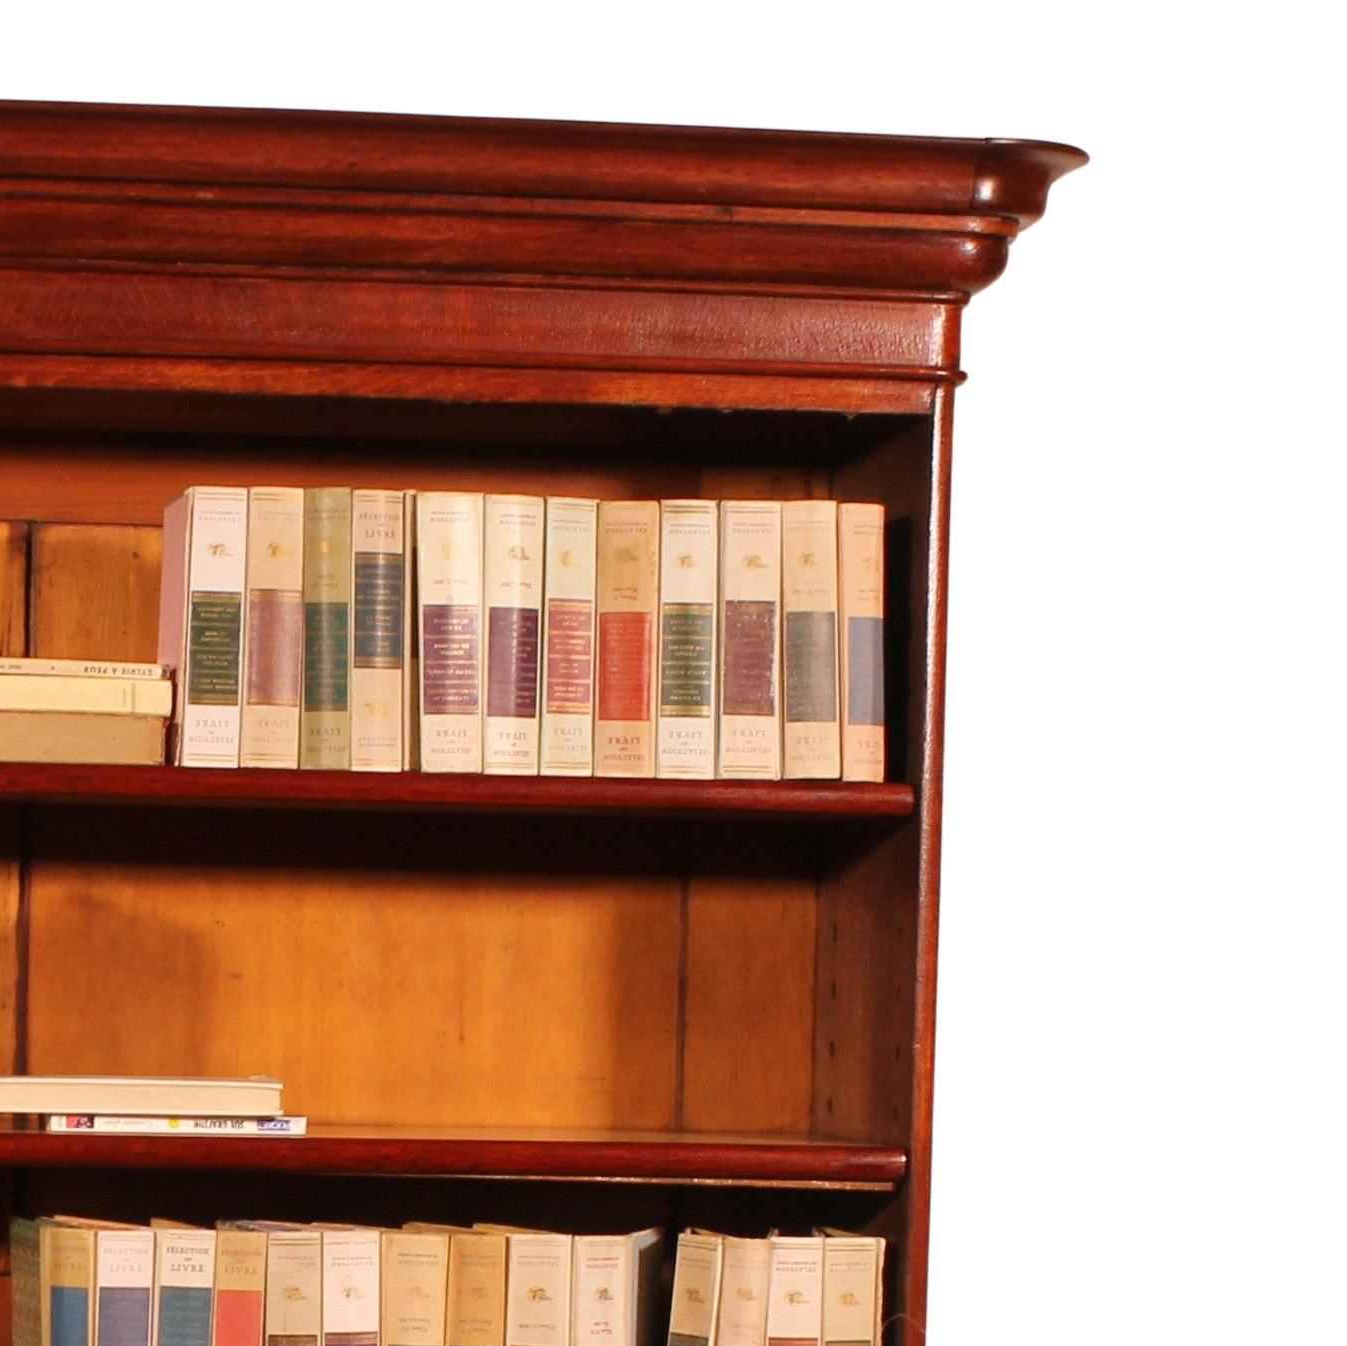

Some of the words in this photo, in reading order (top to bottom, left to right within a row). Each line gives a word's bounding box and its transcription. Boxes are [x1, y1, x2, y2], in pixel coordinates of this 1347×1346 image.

[83, 666, 107, 675] PEUR
[121, 667, 153, 677] SYLVIE
[194, 719, 228, 728] LIVRE
[435, 729, 467, 738] LIVRE
[497, 731, 527, 740] LIVRE
[667, 730, 702, 739] LIVRE
[732, 729, 766, 738] LIVRE
[607, 736, 640, 745] LIVRE
[193, 1119, 228, 1129] GRAFTON
[110, 1264, 143, 1273] LIVRE
[170, 1263, 205, 1273] LIVRE
[225, 1266, 257, 1275] LIVRE
